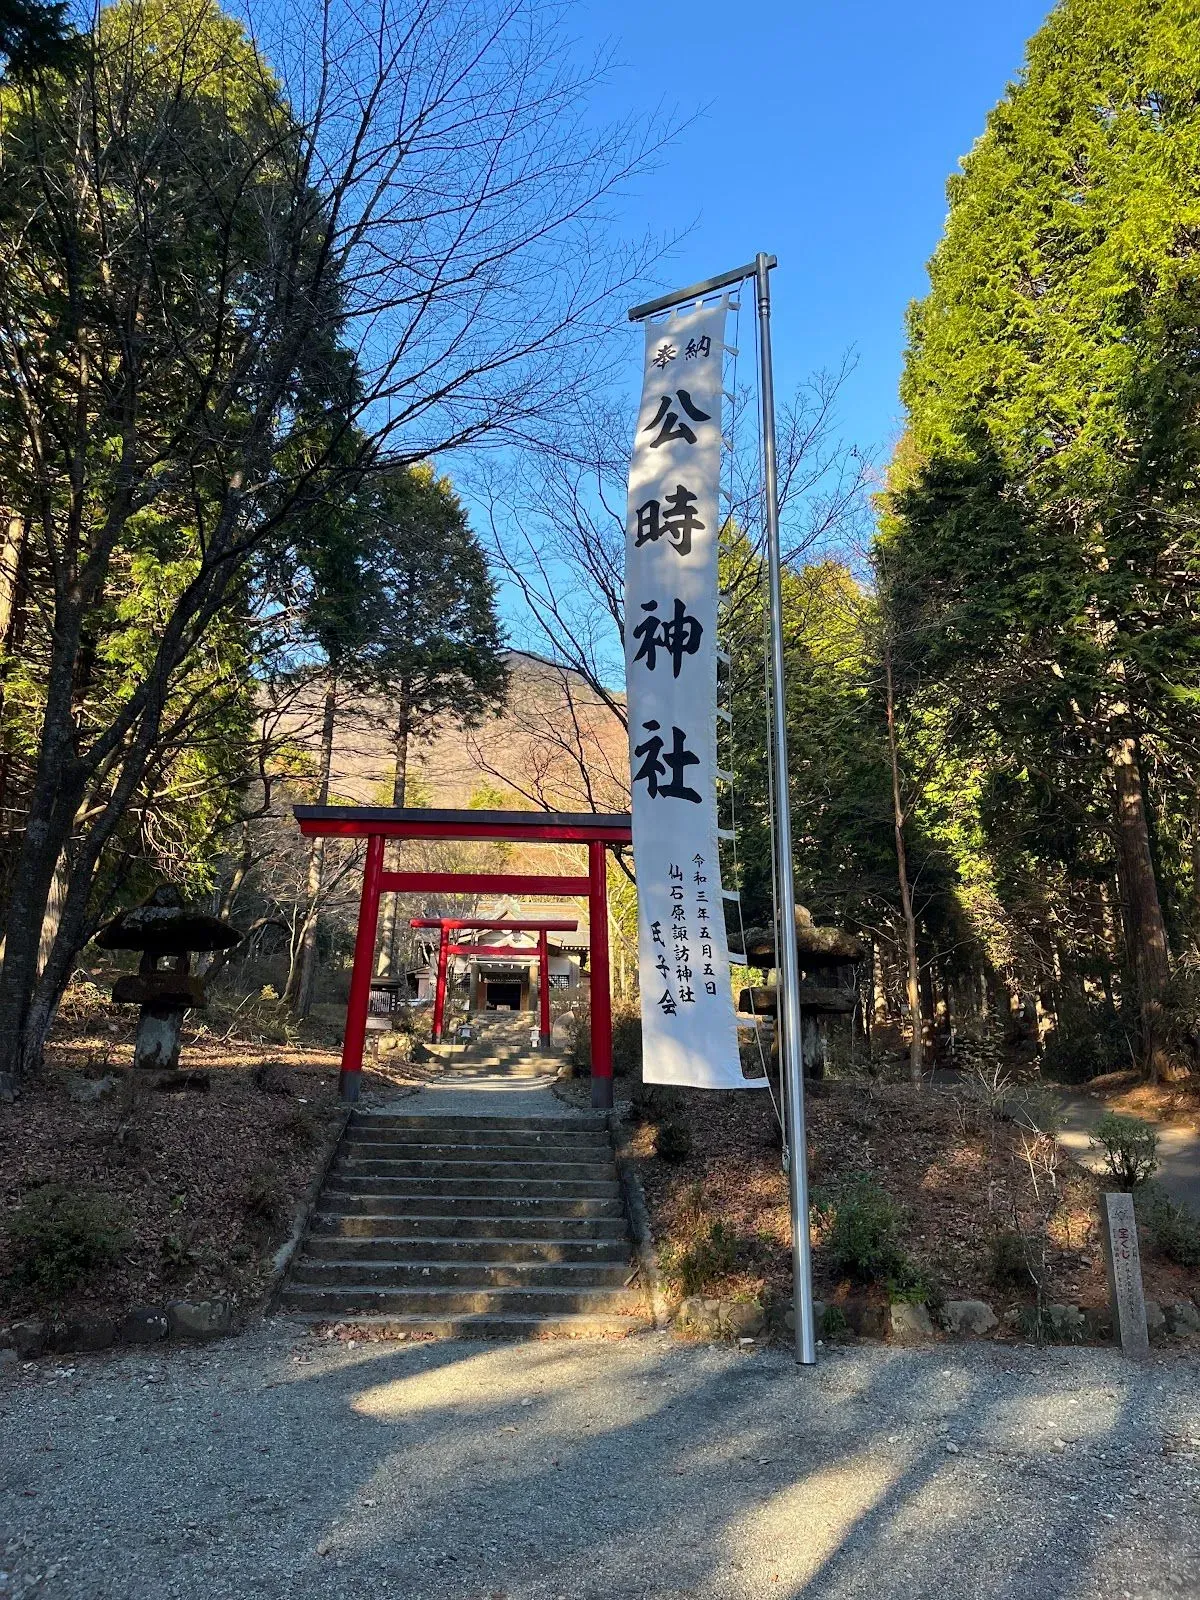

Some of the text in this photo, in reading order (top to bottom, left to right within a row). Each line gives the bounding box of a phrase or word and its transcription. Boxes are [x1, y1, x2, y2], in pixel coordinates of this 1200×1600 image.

[652, 335, 711, 370] 奉納
[633, 389, 711, 803] 公時神社
[650, 920, 677, 1017] 氏子会
[668, 862, 696, 1003] 仙石原諏訪神社
[692, 853, 717, 996] 令和三年五月五日
